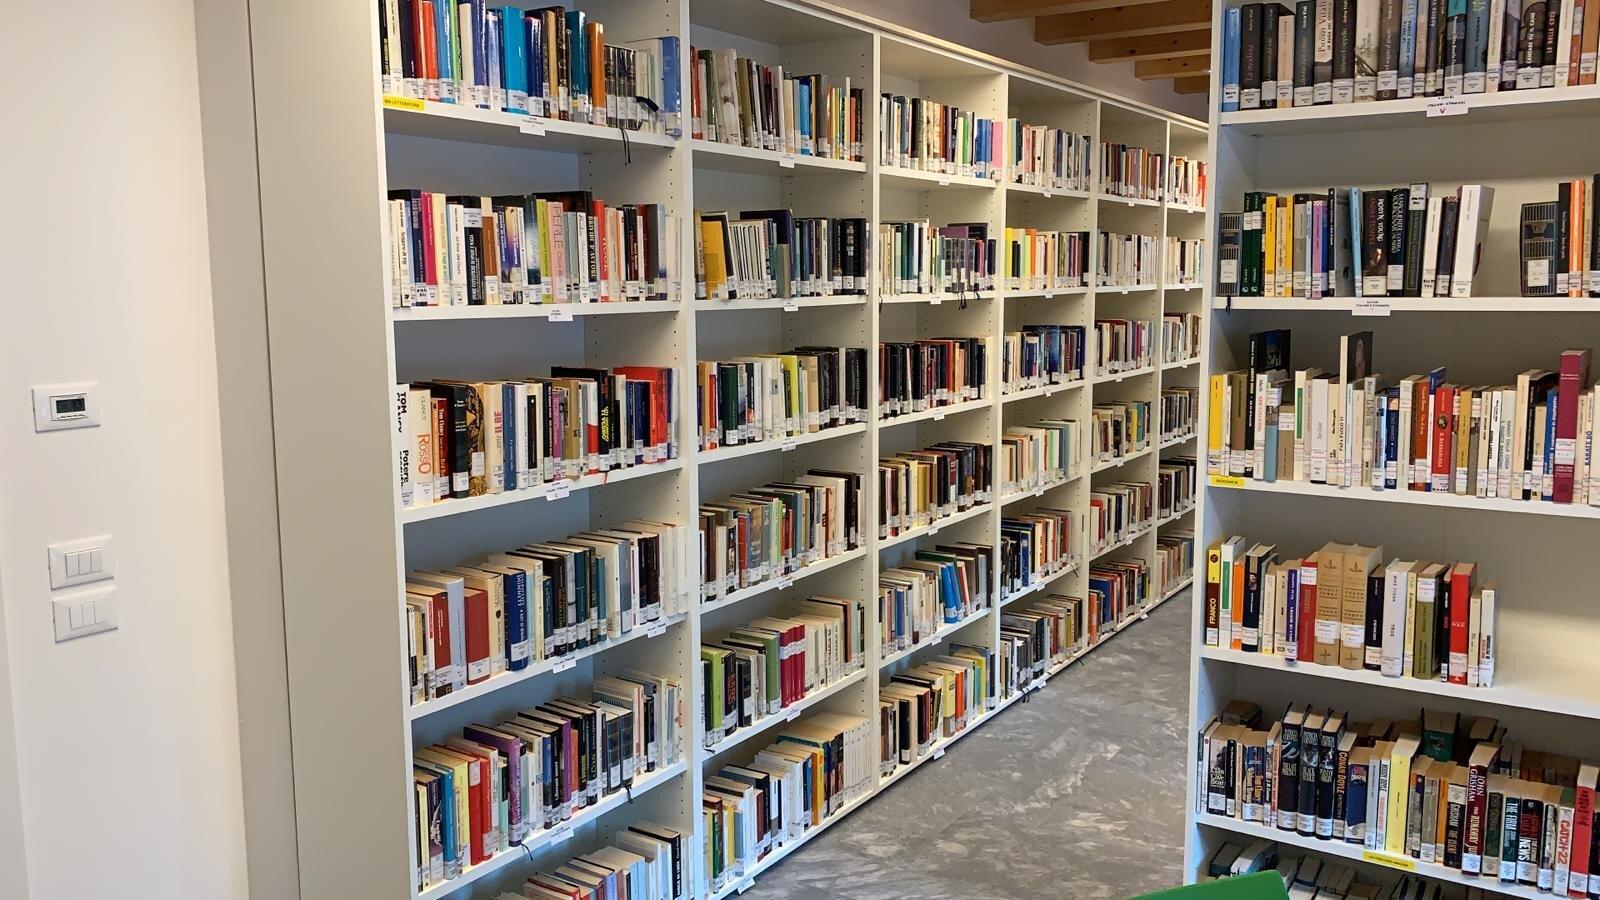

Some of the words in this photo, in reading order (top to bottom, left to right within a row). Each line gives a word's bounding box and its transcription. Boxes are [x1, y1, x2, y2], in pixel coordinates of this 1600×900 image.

[552, 206, 564, 249] PERLE
[1376, 221, 1384, 242] YOUNG
[402, 449, 410, 483] Potere
[1209, 597, 1217, 624] FRANCO
[1338, 751, 1348, 773] CONAN
[1336, 774, 1346, 794] DOYLE
[1468, 768, 1478, 802] GRISHAM
[1476, 775, 1486, 797] JOHN
[1449, 803, 1461, 827] GRISHAM
[1506, 802, 1518, 813] THE
[1468, 815, 1480, 844] RUNAWAY
[1505, 814, 1517, 830] FIRM
[1518, 838, 1531, 861] NEWS
[1557, 820, 1570, 865] CATCH-22
